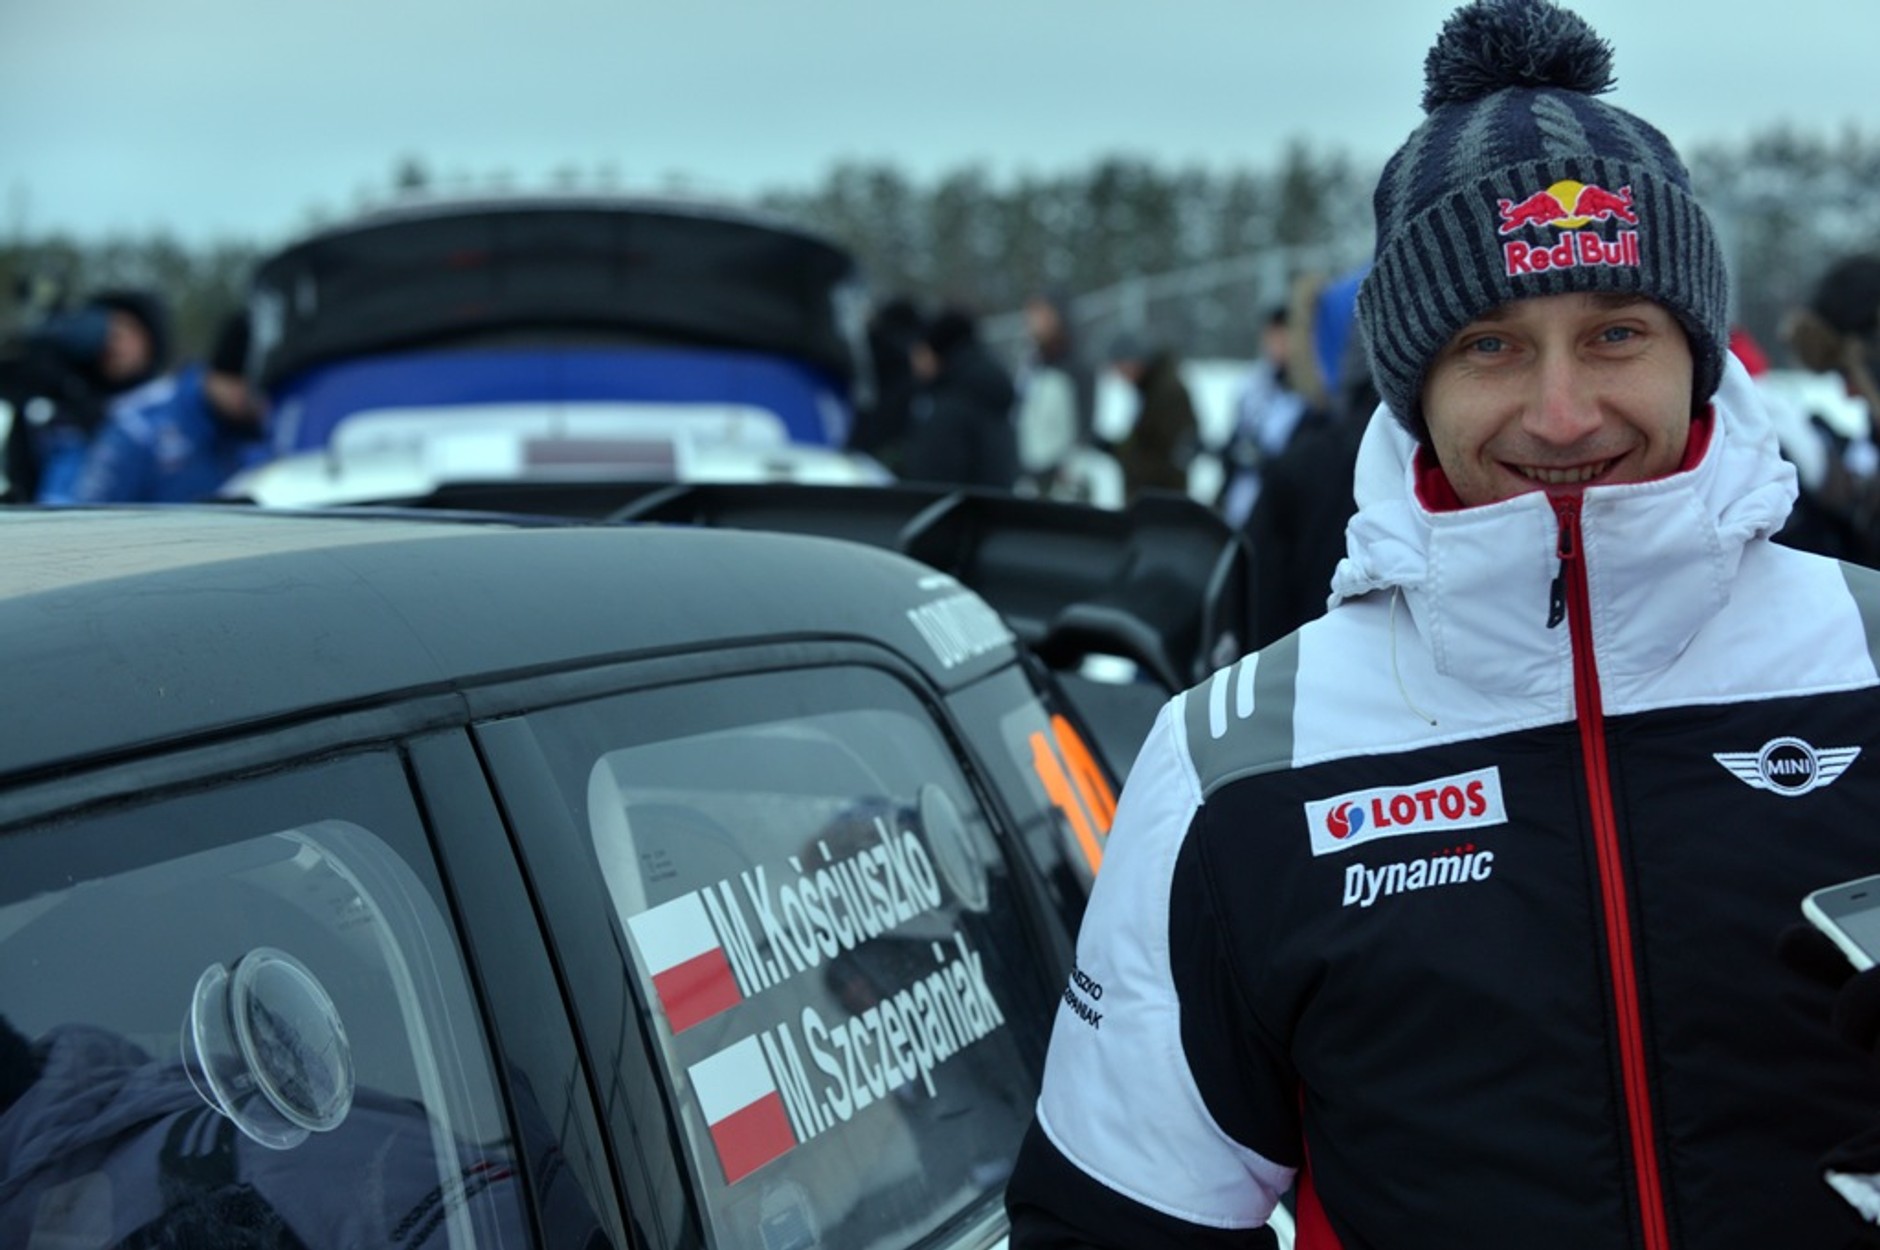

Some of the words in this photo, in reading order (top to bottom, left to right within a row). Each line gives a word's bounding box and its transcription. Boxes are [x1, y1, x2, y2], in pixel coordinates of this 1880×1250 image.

[1504, 231, 1575, 276] Red
[1577, 231, 1640, 267] Bull
[1766, 758, 1811, 775] MINI
[1371, 780, 1487, 828] LOTOS
[1342, 847, 1494, 908] Dynamic
[761, 932, 1004, 1144] M.Szczepaniak
